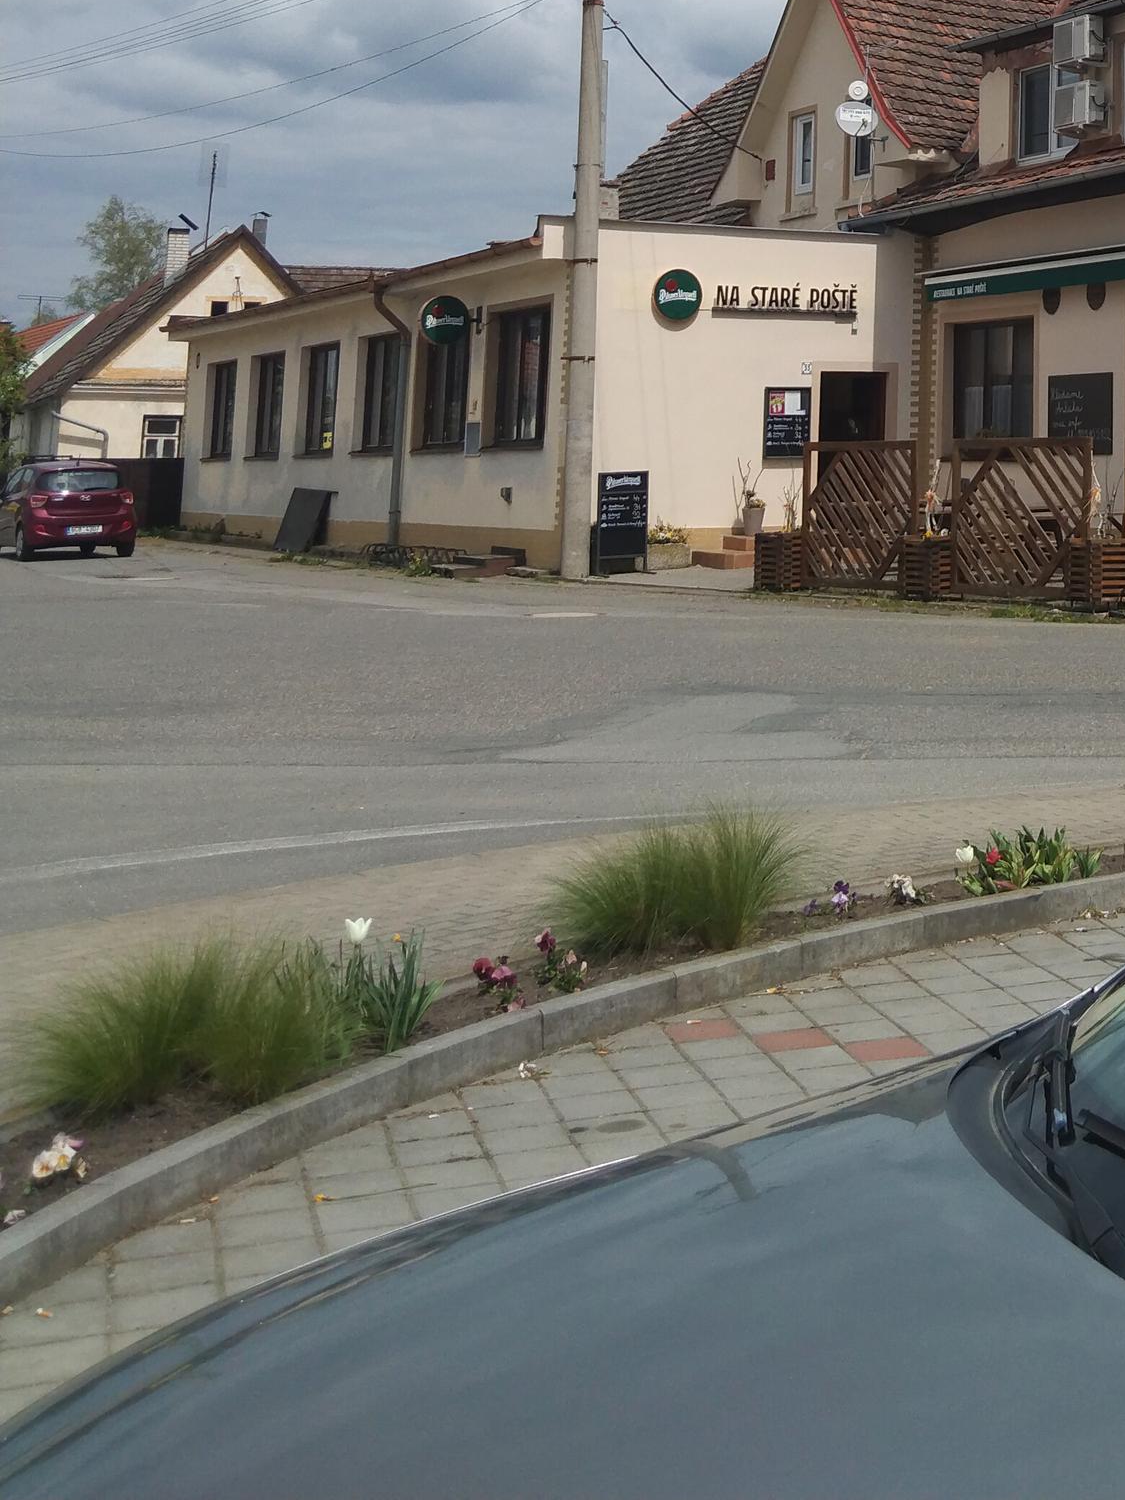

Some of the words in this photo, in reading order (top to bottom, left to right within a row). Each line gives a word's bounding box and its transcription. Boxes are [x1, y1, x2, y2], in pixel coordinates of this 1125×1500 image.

[716, 285, 740, 306] NA
[750, 282, 800, 308] STARÉ
[810, 283, 857, 309] POŠTĚ
